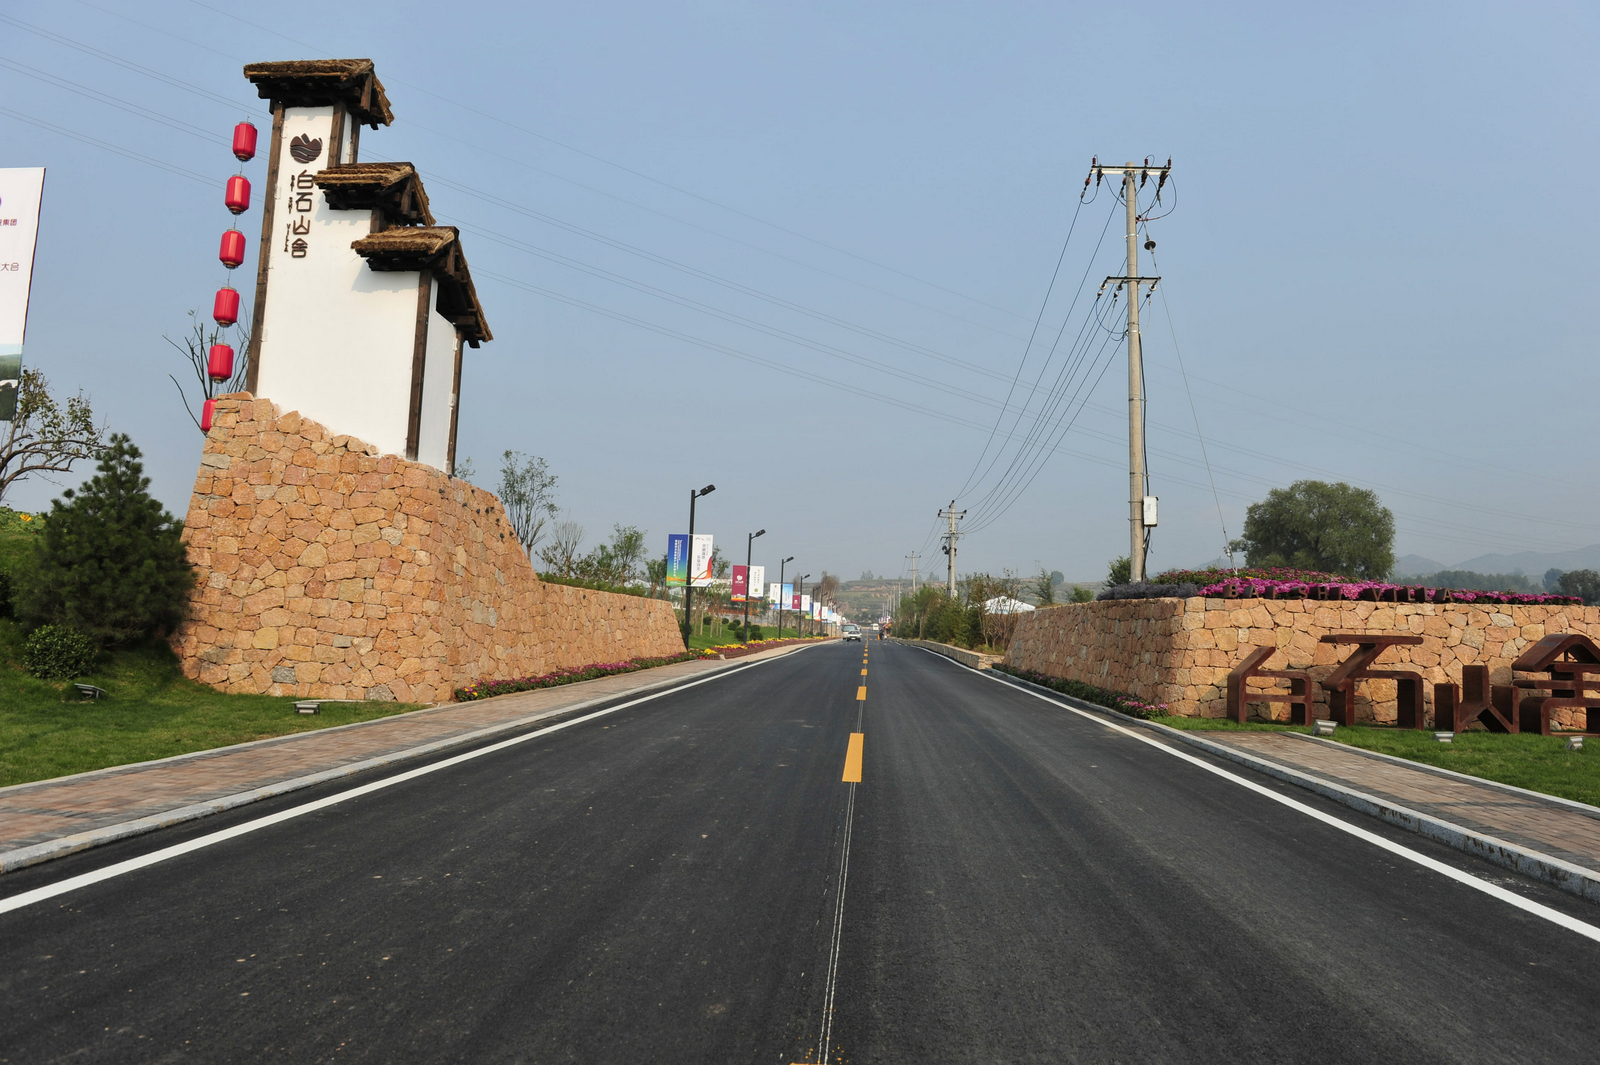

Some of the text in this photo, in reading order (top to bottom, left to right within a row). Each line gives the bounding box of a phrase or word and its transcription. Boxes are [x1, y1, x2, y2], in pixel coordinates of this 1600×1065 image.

[291, 169, 313, 258] 白石山舍
[1223, 584, 1276, 599] BAI
[1362, 587, 1454, 603] VILLA
